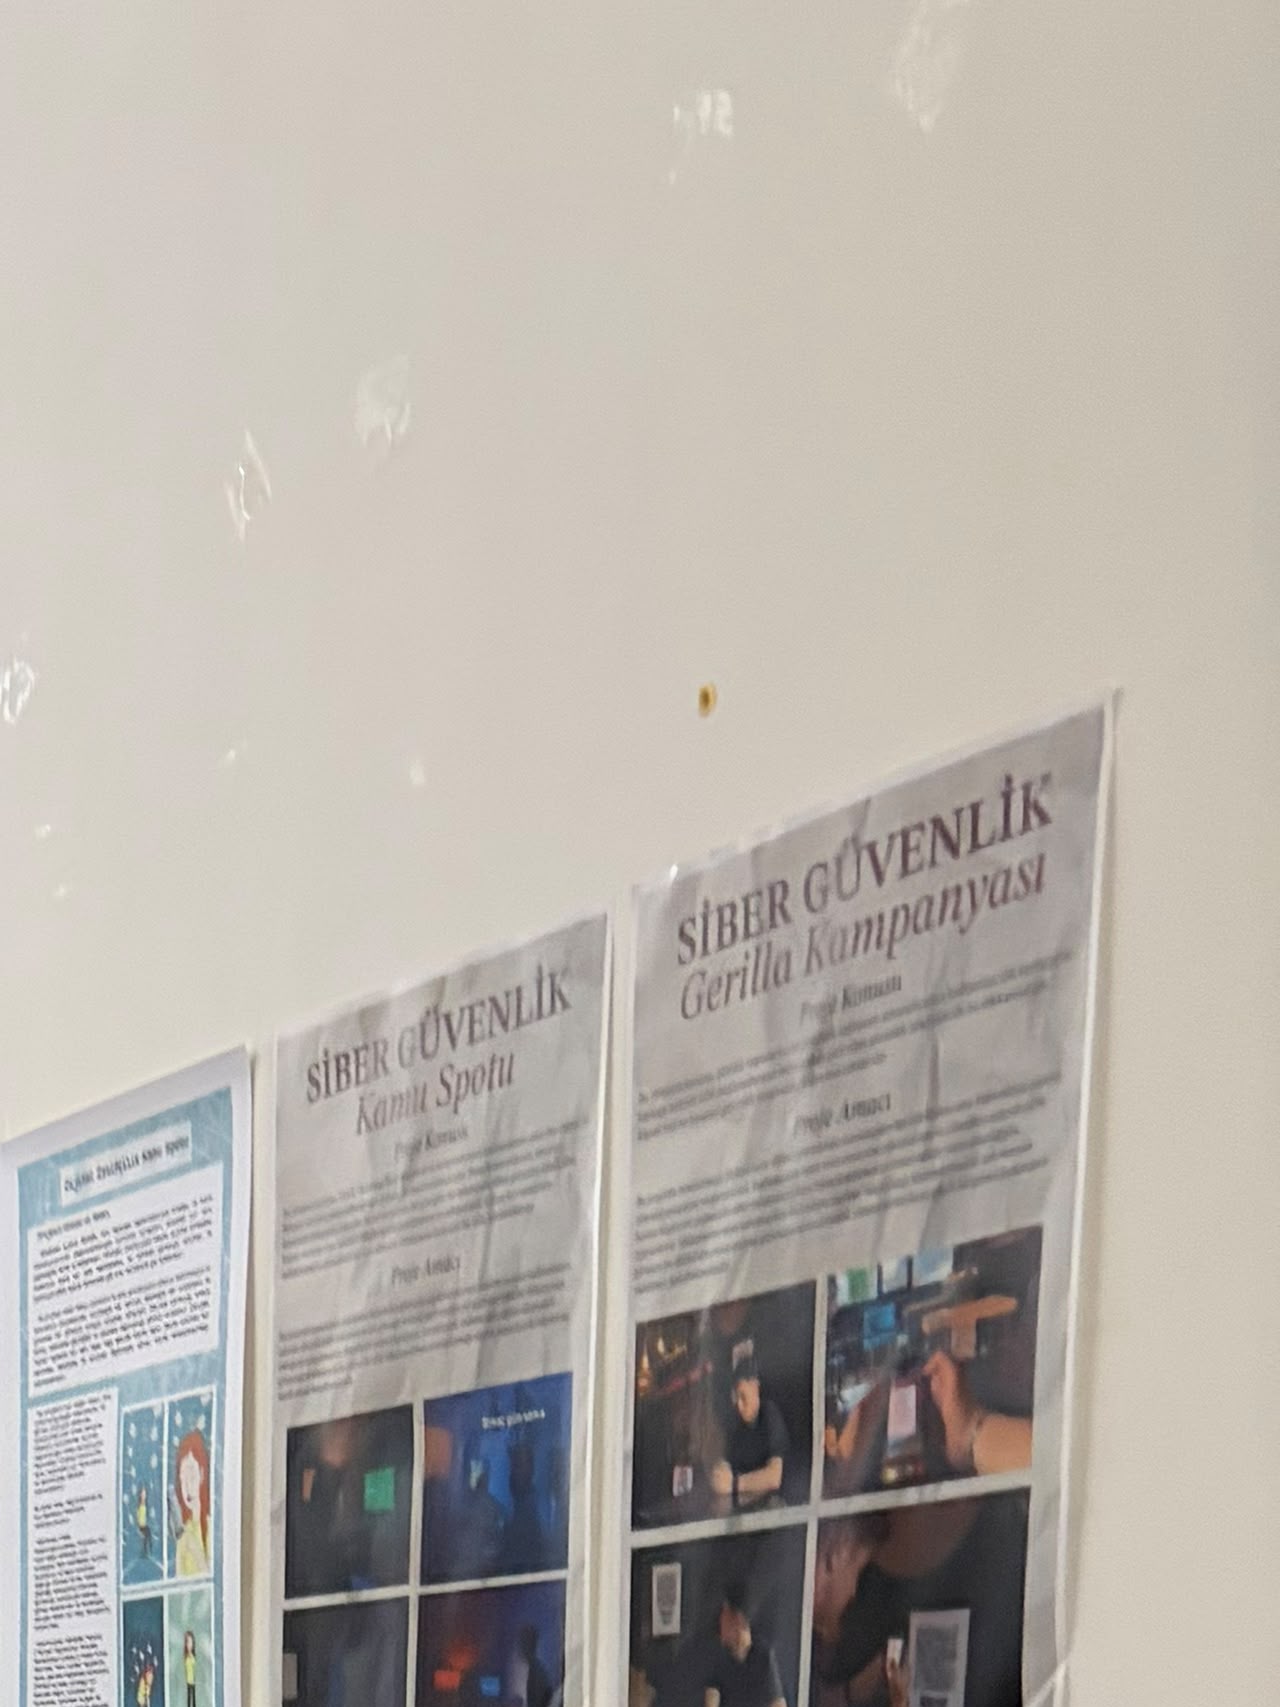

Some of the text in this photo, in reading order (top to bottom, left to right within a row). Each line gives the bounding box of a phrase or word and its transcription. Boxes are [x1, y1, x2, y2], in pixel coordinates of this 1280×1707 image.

[678, 772, 1053, 966] SİBER GÜVENLİK
[681, 853, 1047, 1020] Gerilla Kampanyası
[306, 963, 573, 1104] SİBER GÜVENLİK
[356, 1052, 515, 1135] Kamu Spotu
